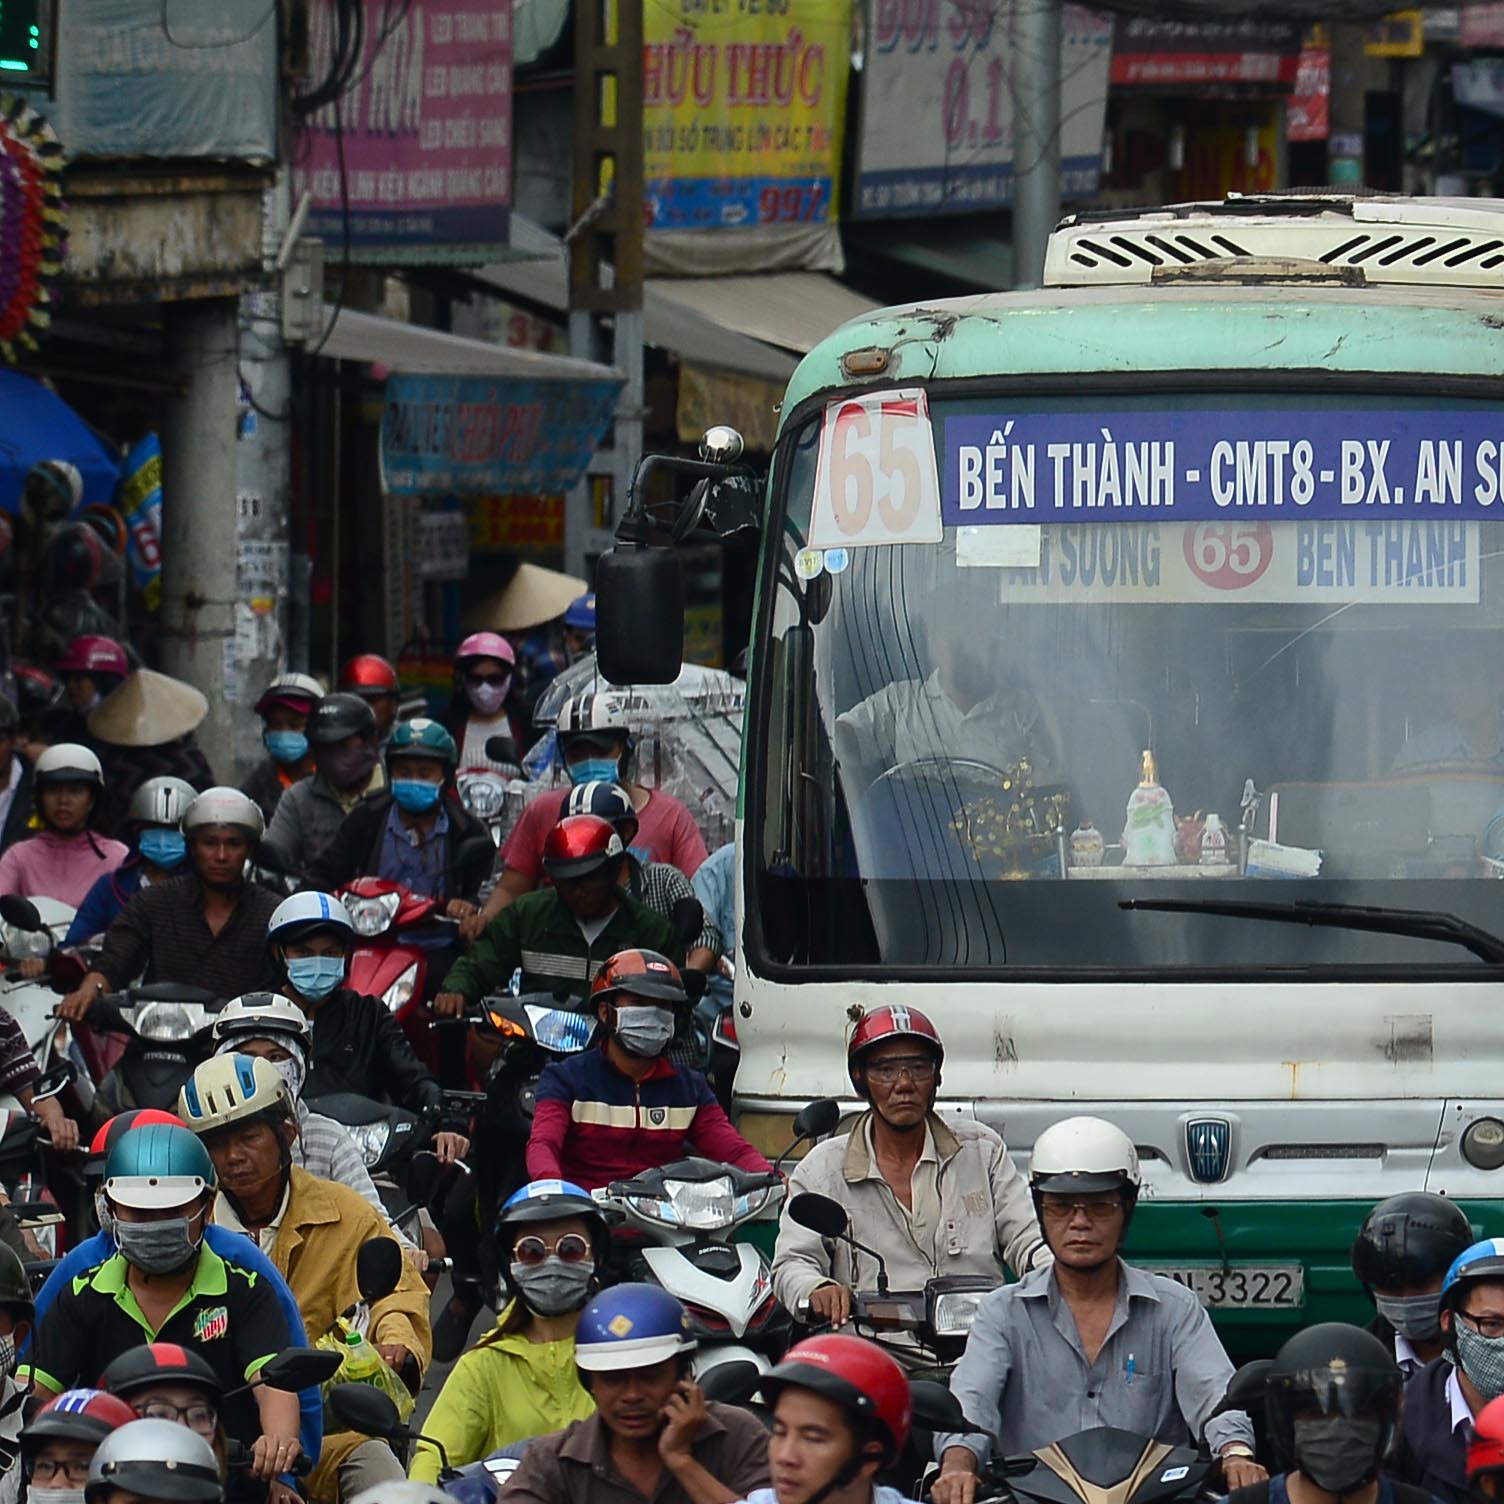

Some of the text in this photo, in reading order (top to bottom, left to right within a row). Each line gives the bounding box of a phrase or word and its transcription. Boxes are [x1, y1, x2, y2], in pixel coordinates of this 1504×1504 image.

[829, 401, 923, 537] 65
[958, 420, 1036, 511] BẾN
[1047, 428, 1175, 508] THÀNH
[1414, 439, 1463, 504] AN
[1198, 520, 1263, 575] 65
